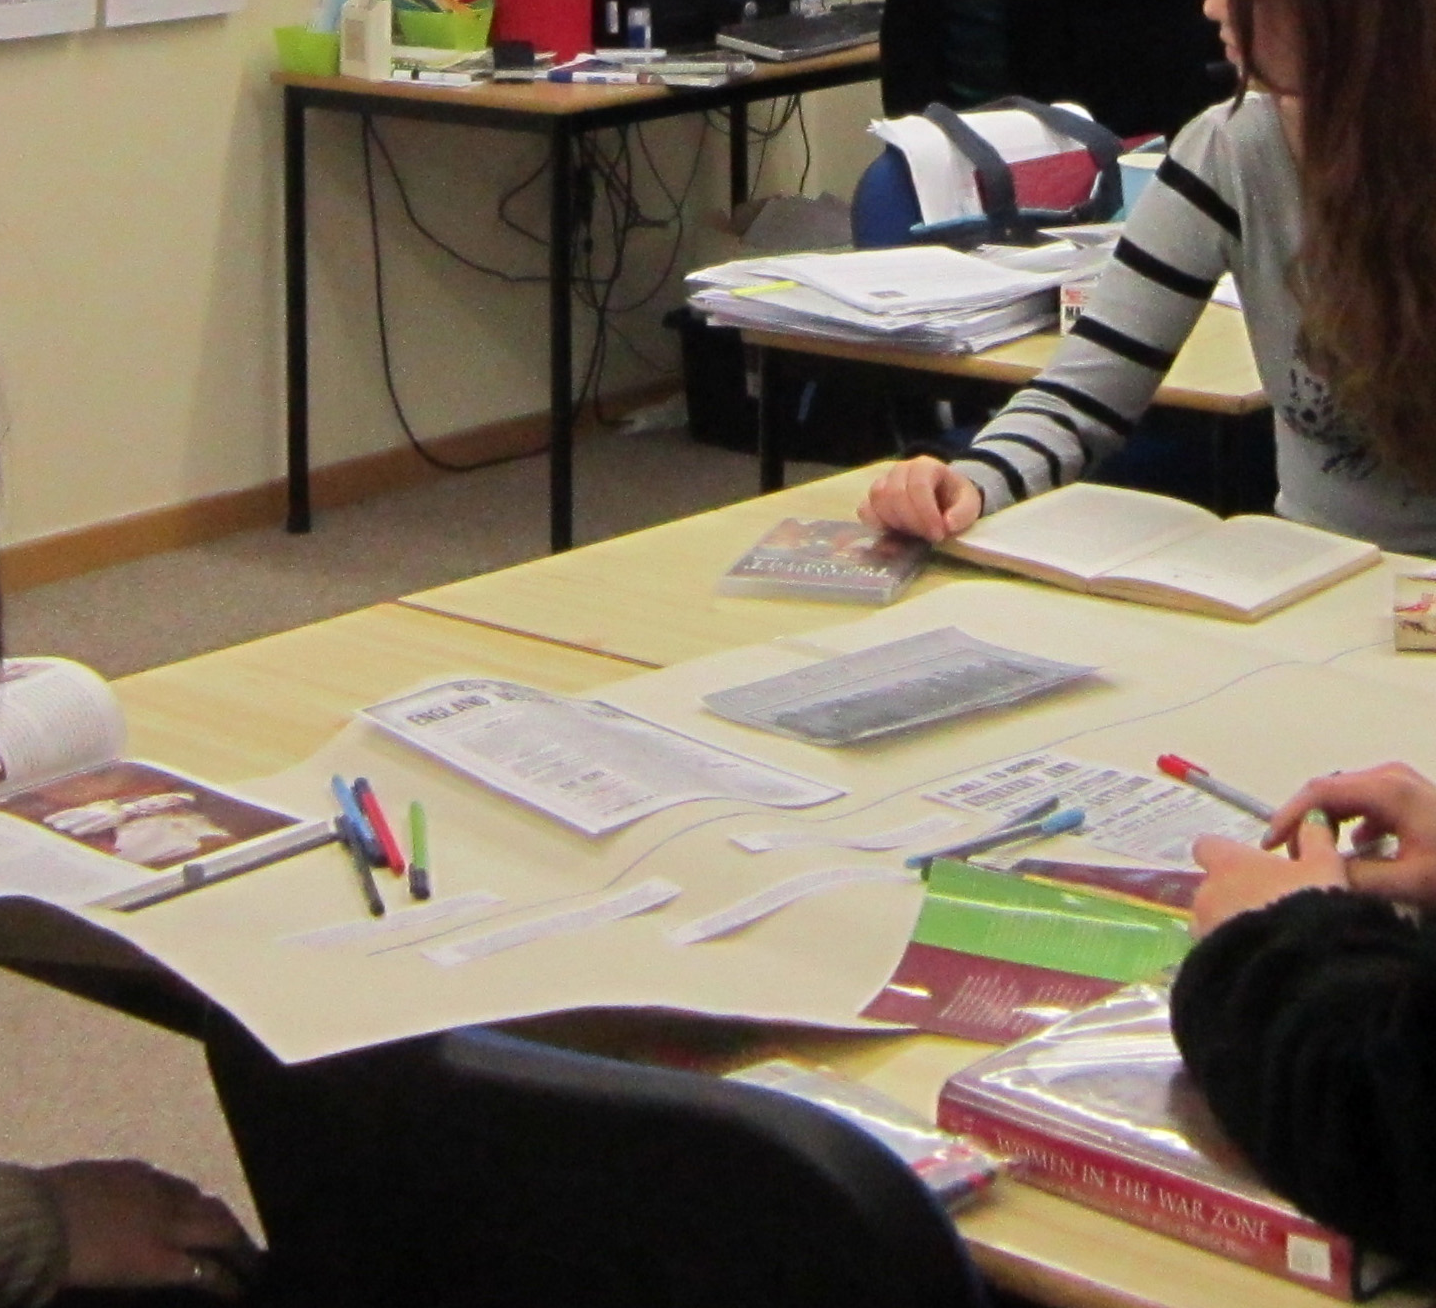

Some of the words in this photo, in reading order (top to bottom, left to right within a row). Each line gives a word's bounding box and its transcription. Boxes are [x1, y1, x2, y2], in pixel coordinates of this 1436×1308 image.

[407, 695, 490, 726] ENGLAND
[996, 1128, 1074, 1179] WOMEN
[1082, 1164, 1105, 1187] IN
[1113, 1173, 1149, 1203] THE
[1158, 1187, 1205, 1222] WAR
[1211, 1206, 1268, 1240] ZONE
